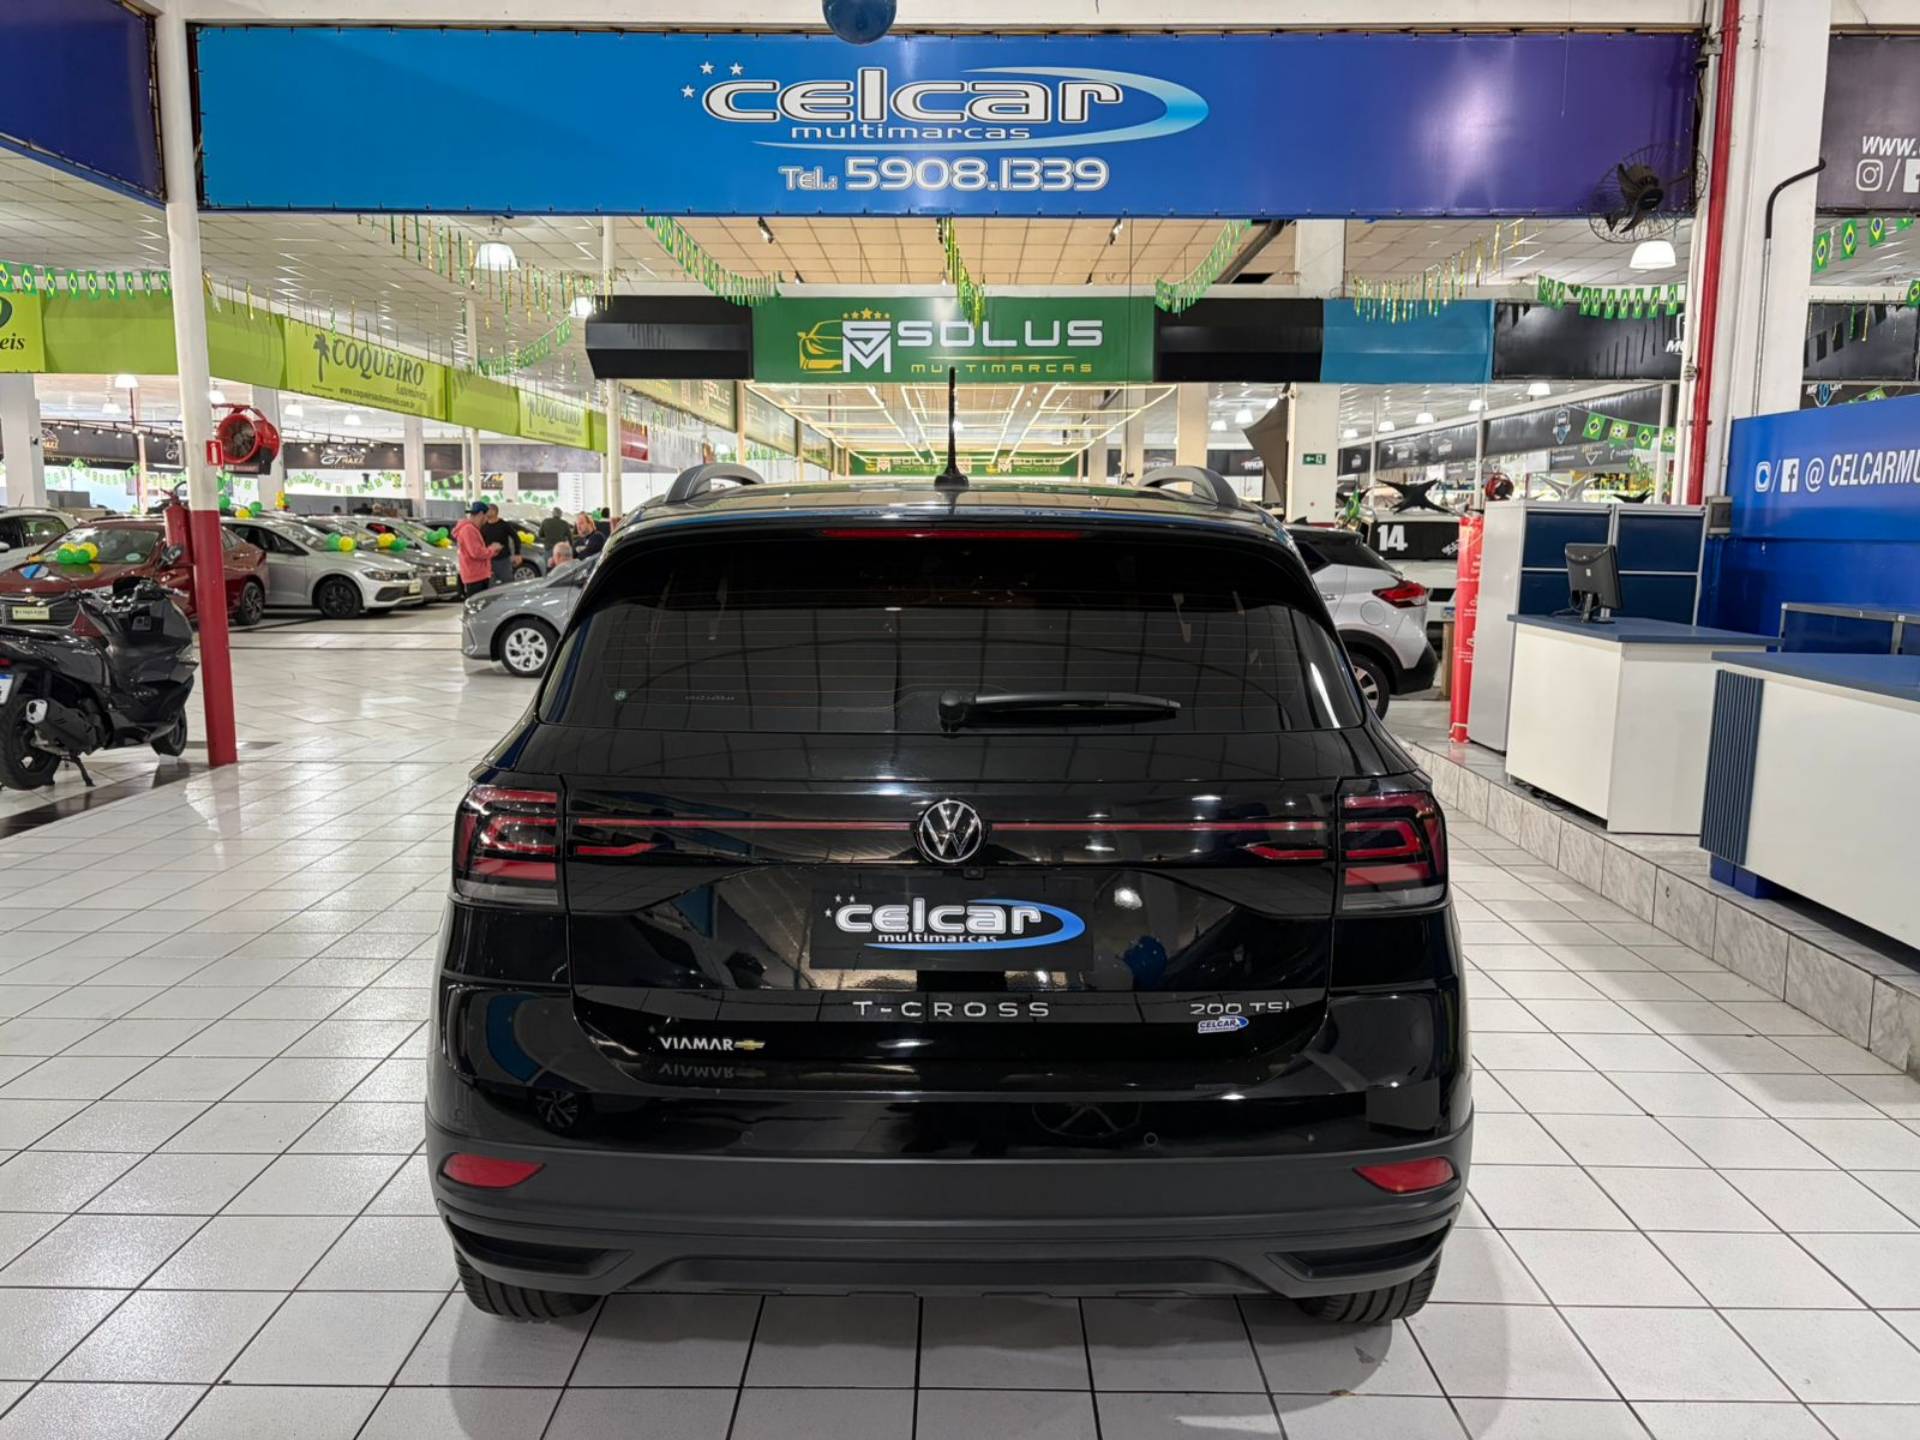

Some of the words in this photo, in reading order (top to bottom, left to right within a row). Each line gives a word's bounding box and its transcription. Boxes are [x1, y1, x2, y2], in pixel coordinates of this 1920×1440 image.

[702, 67, 1123, 124] celcar
[791, 124, 1031, 139] multimarcas
[1862, 135, 1920, 156] www.
[845, 156, 1109, 192] 5908.1339
[897, 319, 1104, 347] SOLUS
[332, 339, 425, 386] COQUEIRO
[1377, 524, 1409, 551] 14
[835, 898, 1042, 934] celcar
[878, 932, 998, 943] multimarcas
[852, 1001, 1050, 1018] T-CROSS
[1190, 1003, 1242, 1015] 200
[1248, 1001, 1290, 1013] TSI
[659, 1036, 734, 1051] VIAMAR
